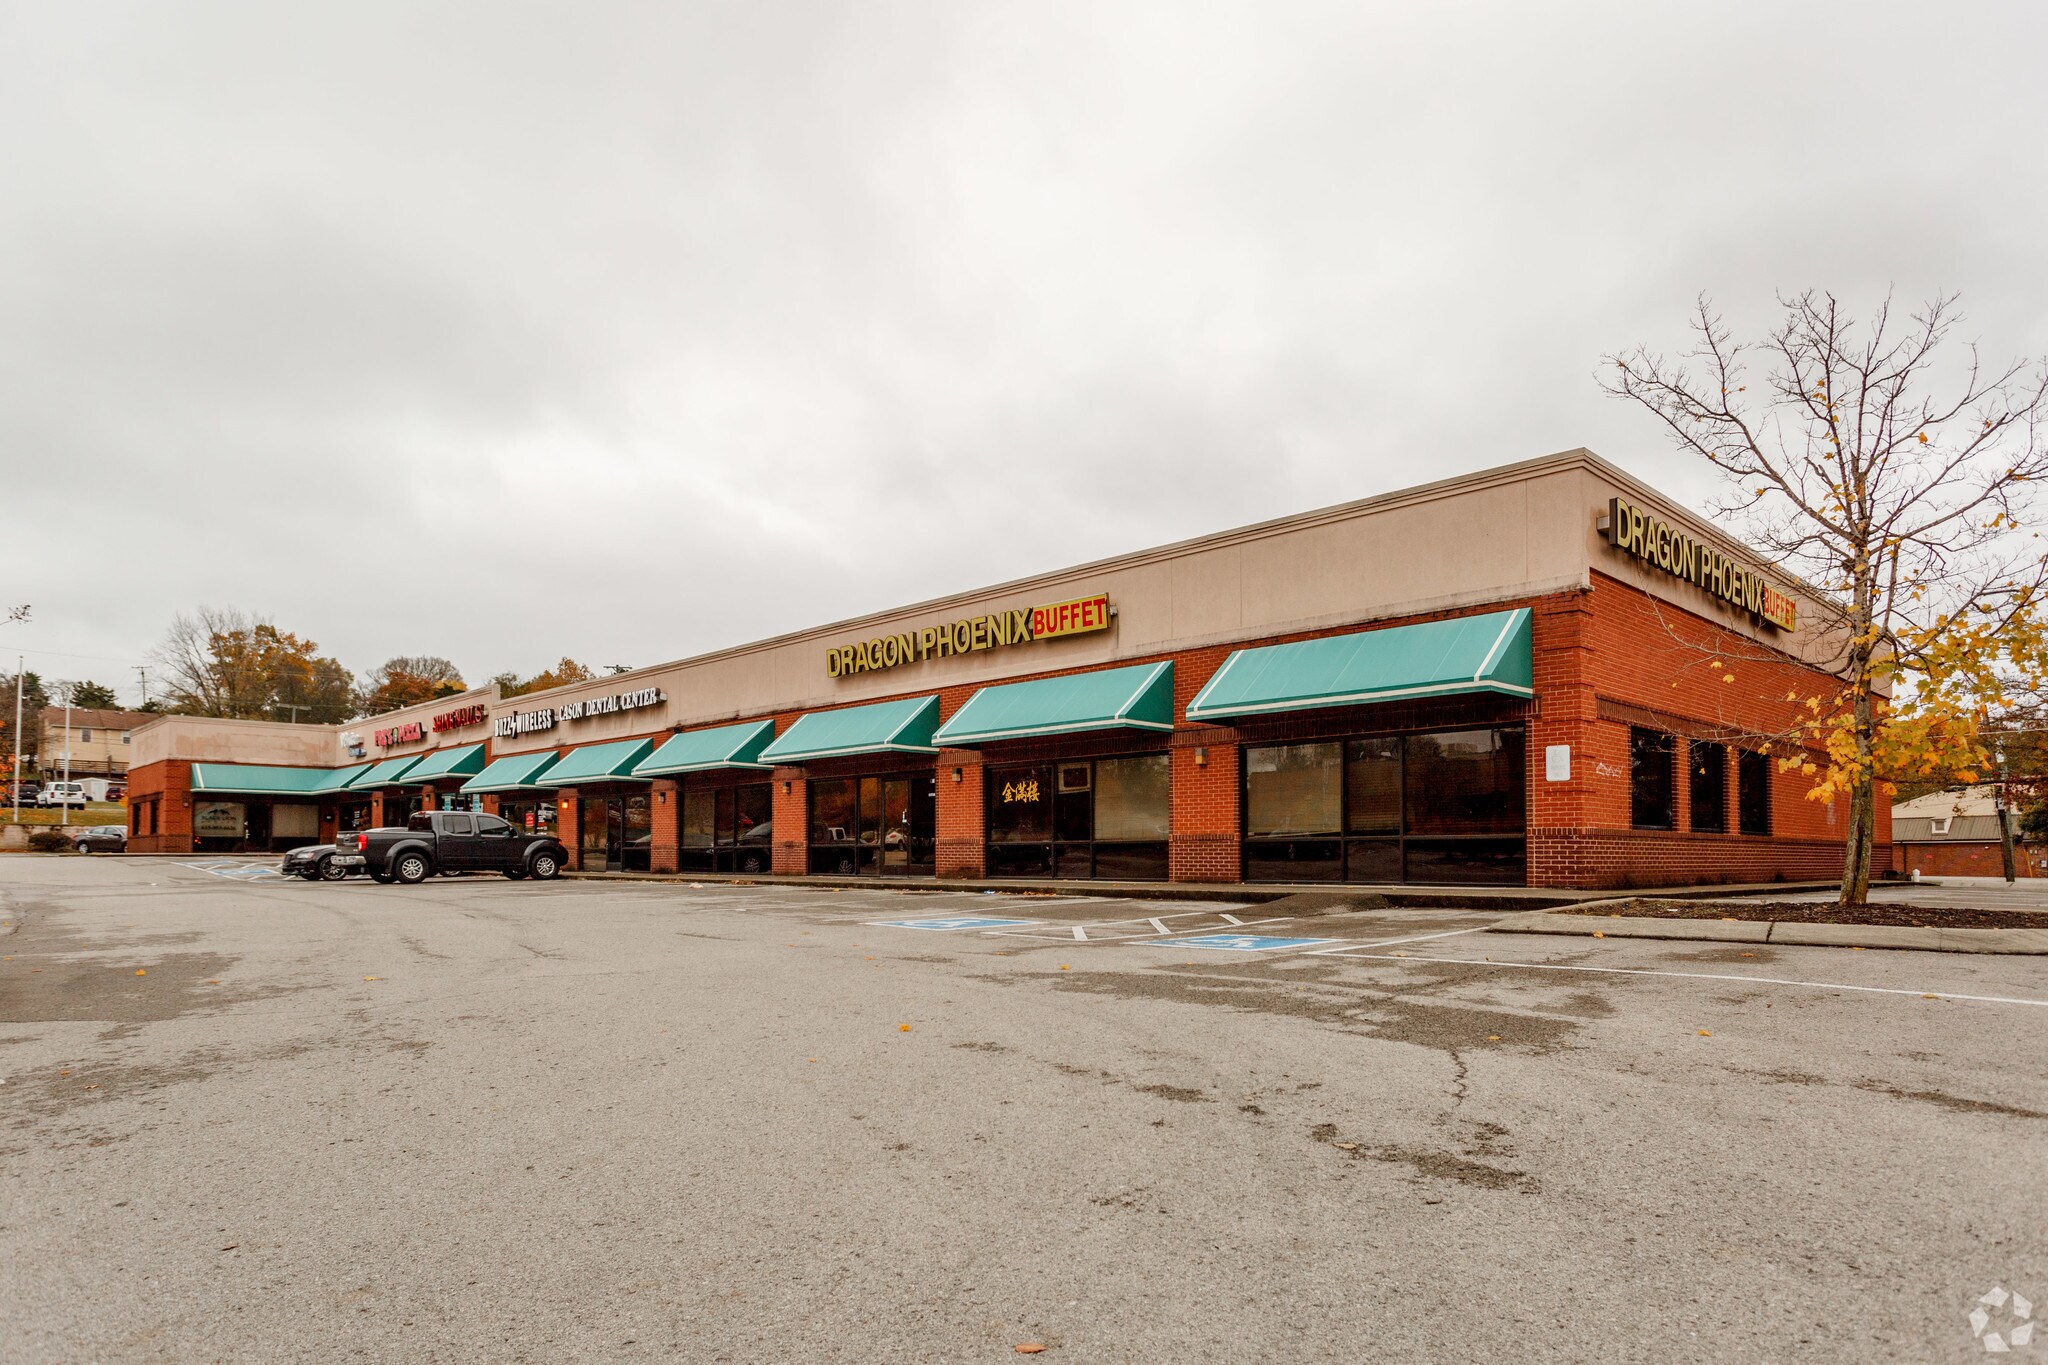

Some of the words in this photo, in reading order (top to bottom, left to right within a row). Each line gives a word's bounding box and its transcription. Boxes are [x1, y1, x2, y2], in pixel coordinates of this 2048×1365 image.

[1616, 497, 1696, 582] DRAGON
[1701, 544, 1765, 616] PHOENIX
[1764, 585, 1796, 626] BUFFET
[826, 631, 916, 678] DRAGON
[921, 608, 1031, 660] PHOENIX
[1034, 597, 1107, 636] BUFFET
[455, 704, 482, 728] NAILS
[559, 702, 584, 721] CASON
[586, 695, 619, 716] DENTAL
[622, 687, 657, 710] CENTER
[494, 717, 512, 737] BUZZ
[516, 709, 552, 733] WIRELESS
